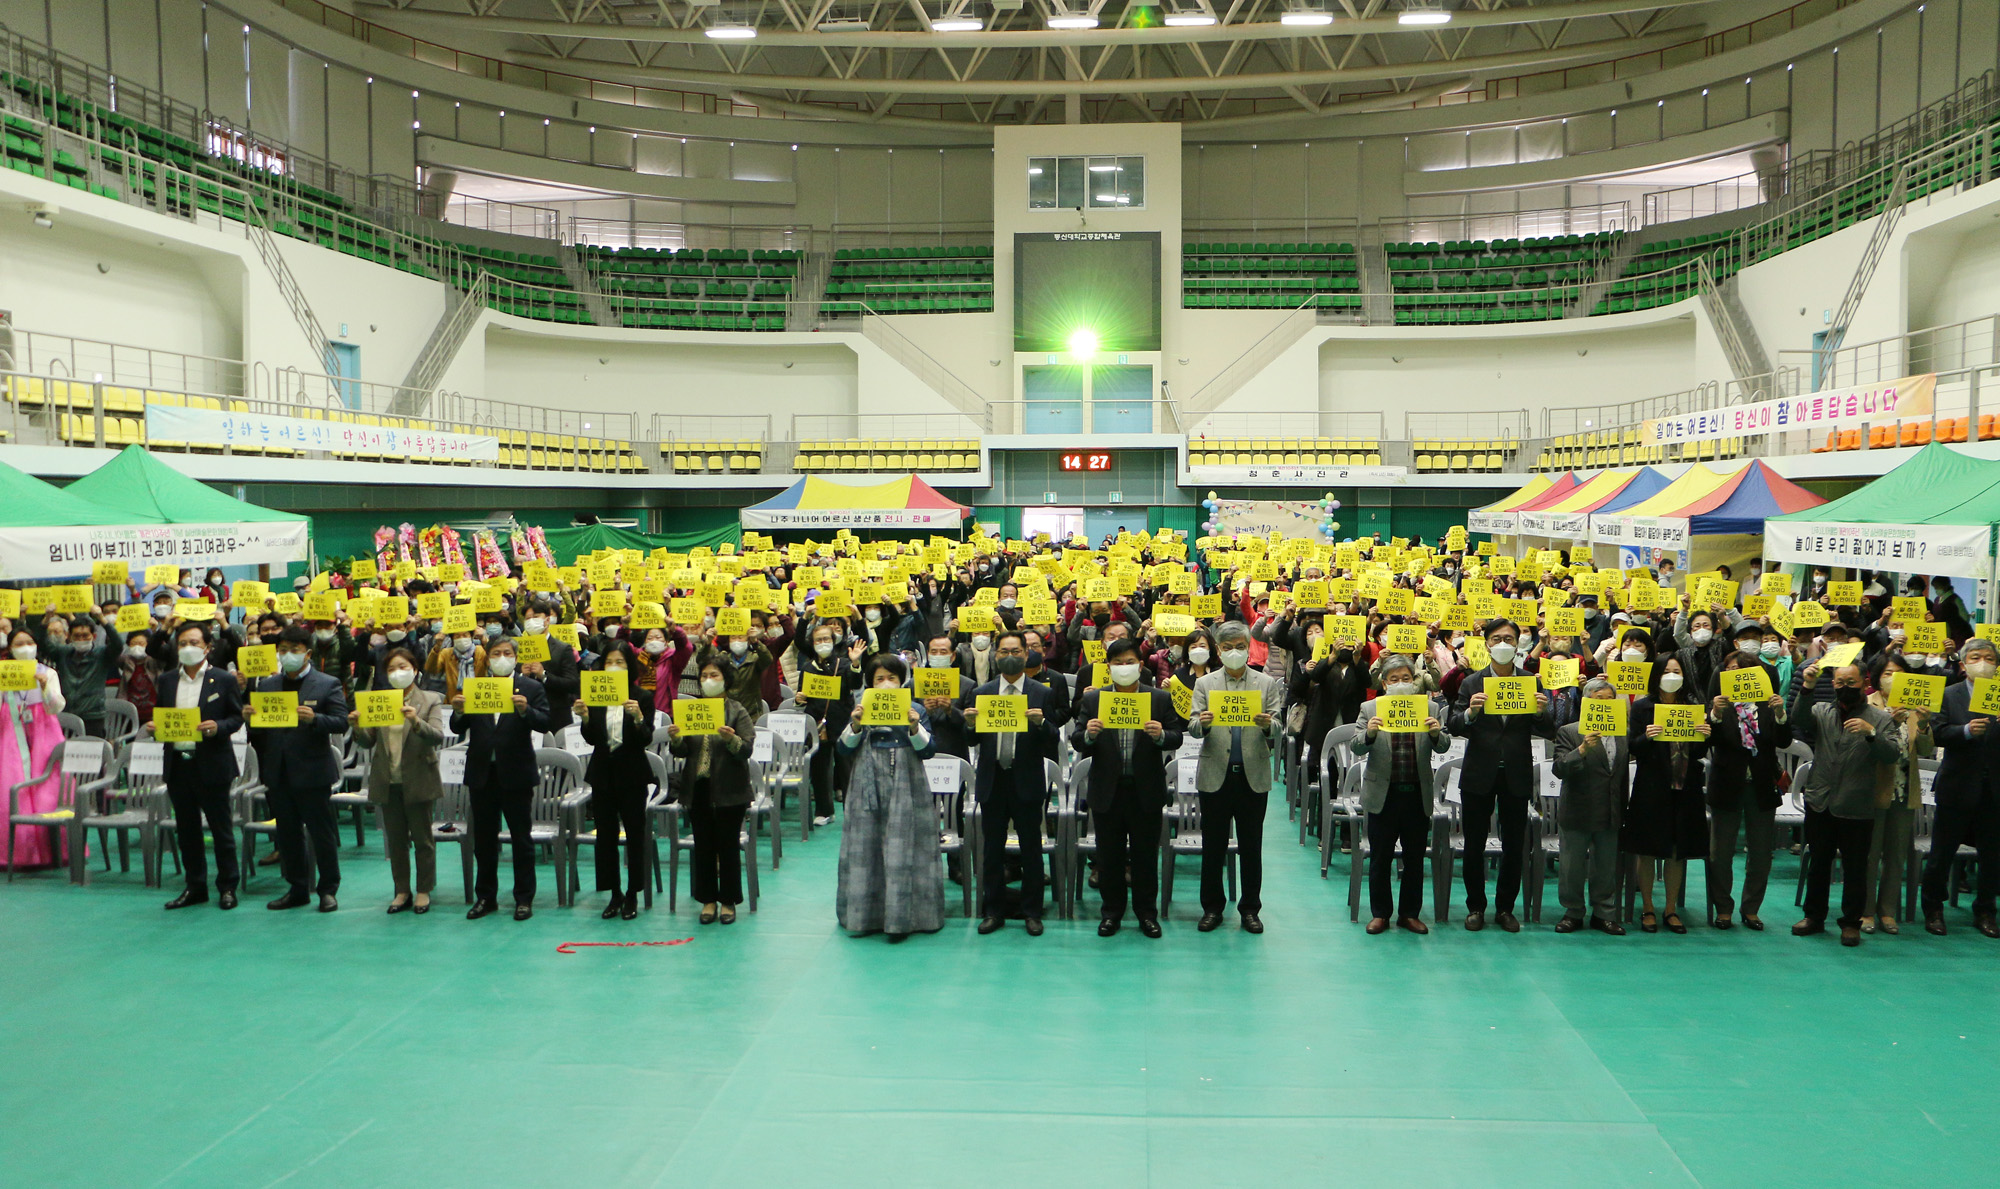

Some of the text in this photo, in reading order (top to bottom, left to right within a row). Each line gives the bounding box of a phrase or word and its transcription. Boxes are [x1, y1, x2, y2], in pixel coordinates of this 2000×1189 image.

[1777, 400, 1790, 425] 참
[386, 430, 397, 451] 참
[1063, 455, 1109, 470] 14 27
[1828, 536, 1848, 554] 우리
[49, 542, 85, 562] 엄니!
[90, 540, 136, 560] 아부지!
[141, 538, 177, 557] 건강이
[1916, 626, 1936, 634] 우리는
[1394, 642, 1419, 650] 노인이다
[1912, 641, 1939, 649] 노인이다
[245, 665, 270, 674] 노인이다
[1620, 666, 1642, 674] 우리는
[592, 676, 614, 684] 우리는
[926, 672, 946, 680] 우리는
[1735, 672, 1757, 683] 우리는
[477, 682, 498, 690] 우리는
[1499, 682, 1522, 690] 우리는
[1616, 683, 1645, 691] 노인이다
[1907, 678, 1930, 688] 우리는
[922, 688, 951, 696] 노인이다
[1732, 690, 1764, 700] 노인이다
[263, 696, 284, 704] 우리는
[369, 695, 389, 704] 우리는
[590, 694, 619, 702] 노인이다
[874, 693, 896, 702] 우리는
[1113, 697, 1136, 706] 우리는
[1224, 696, 1246, 704] 우리는
[474, 700, 503, 709] 노인이다
[990, 700, 1013, 708] 우리는
[1391, 700, 1413, 708] 우리는
[1495, 701, 1527, 710] 노인이다
[1899, 697, 1931, 708] 노인이다
[688, 704, 709, 712] 우리는
[1589, 704, 1612, 713] 우리는
[261, 714, 289, 722] 노인이다
[367, 713, 395, 723] 노인이다
[871, 712, 901, 721] 노인이다
[1219, 714, 1251, 722] 노인이다
[1669, 709, 1693, 718] 우리는
[987, 719, 1018, 728] 노인이다
[1109, 716, 1140, 725] 노인이다
[1387, 719, 1418, 728] 노인이다
[685, 722, 715, 730] 노인이다
[1585, 723, 1616, 732] 노인이다
[1664, 728, 1695, 737] 노인이다
